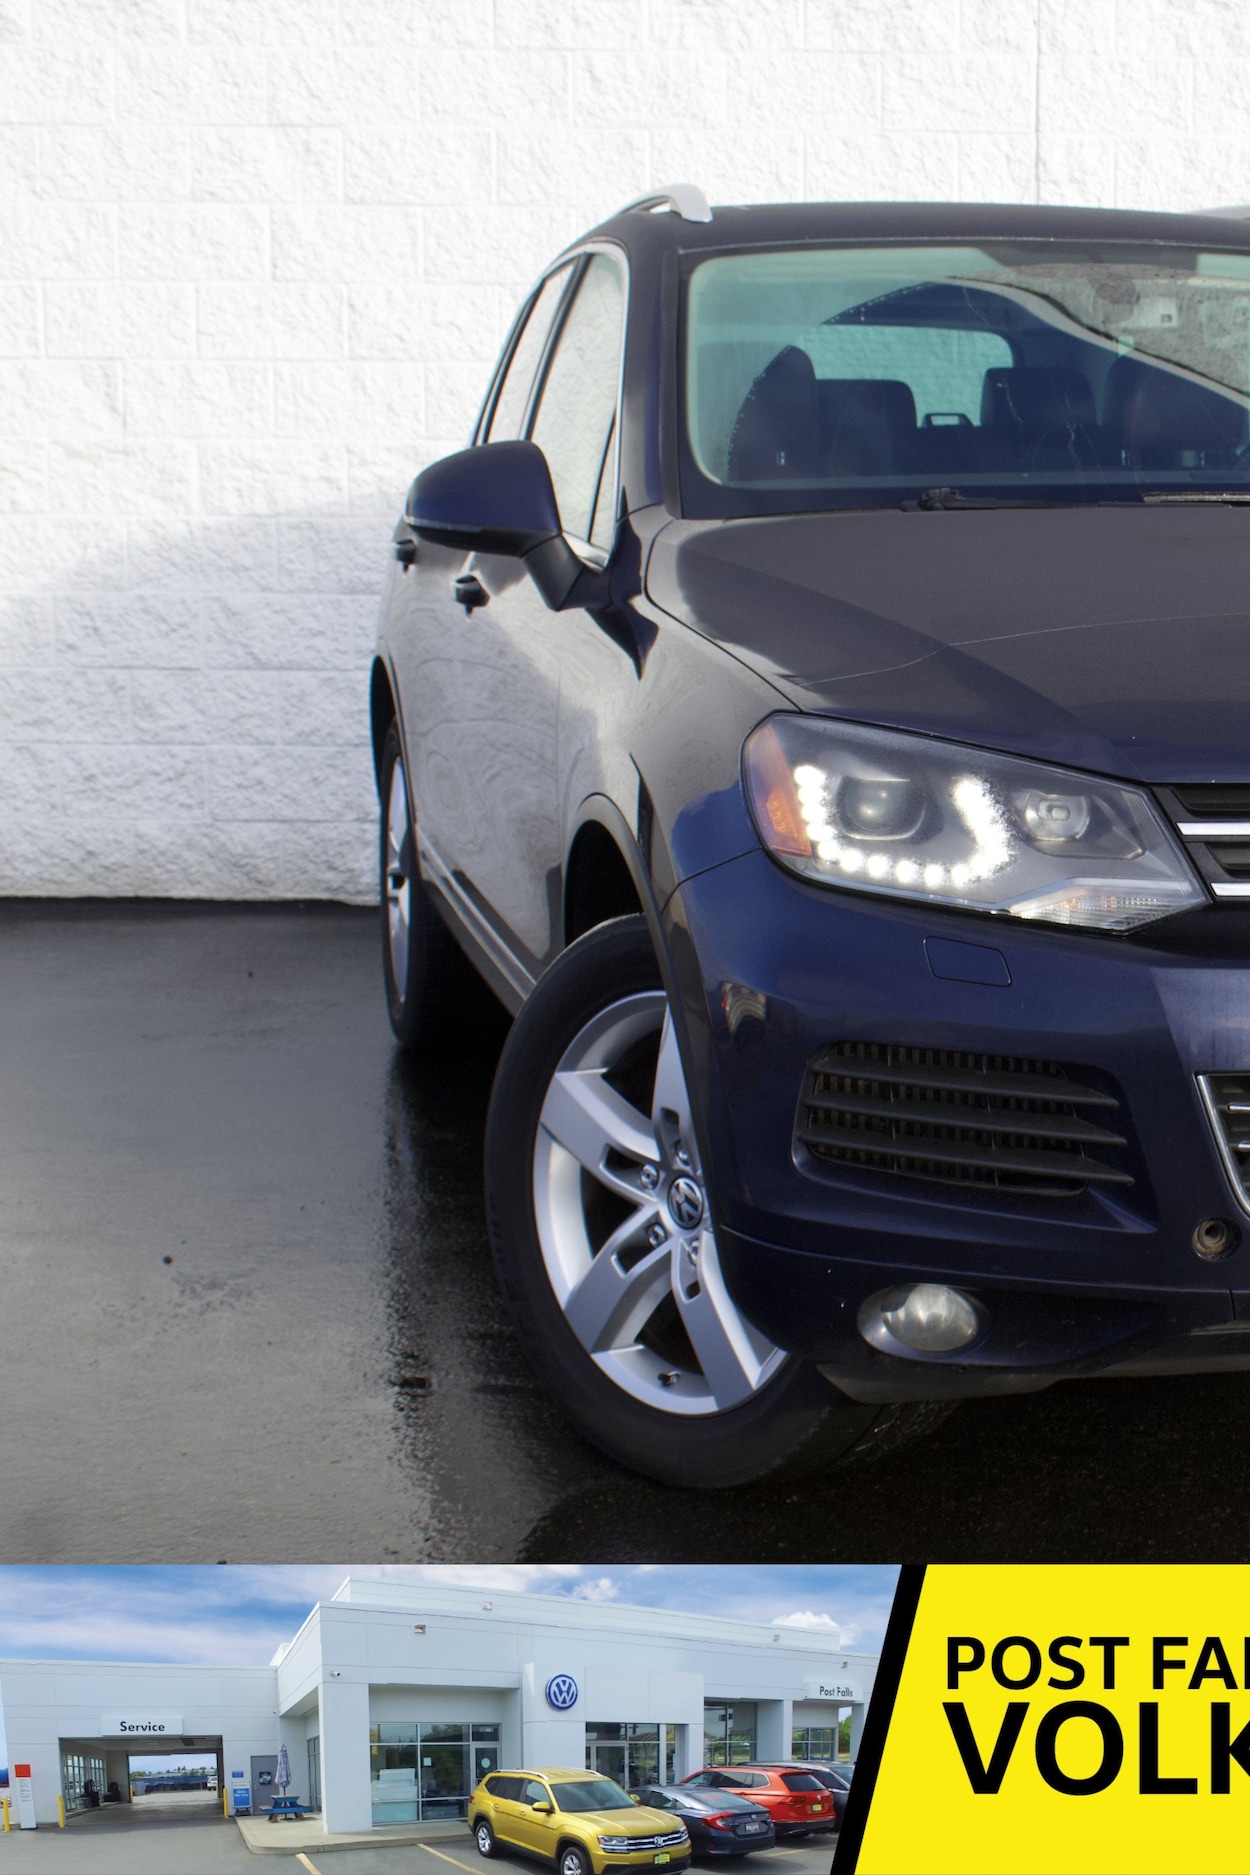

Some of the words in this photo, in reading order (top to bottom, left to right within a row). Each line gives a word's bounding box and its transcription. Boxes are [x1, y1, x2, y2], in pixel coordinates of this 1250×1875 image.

[819, 1685, 835, 1697] Post
[836, 1686, 853, 1698] Falls
[119, 1720, 166, 1732] Service
